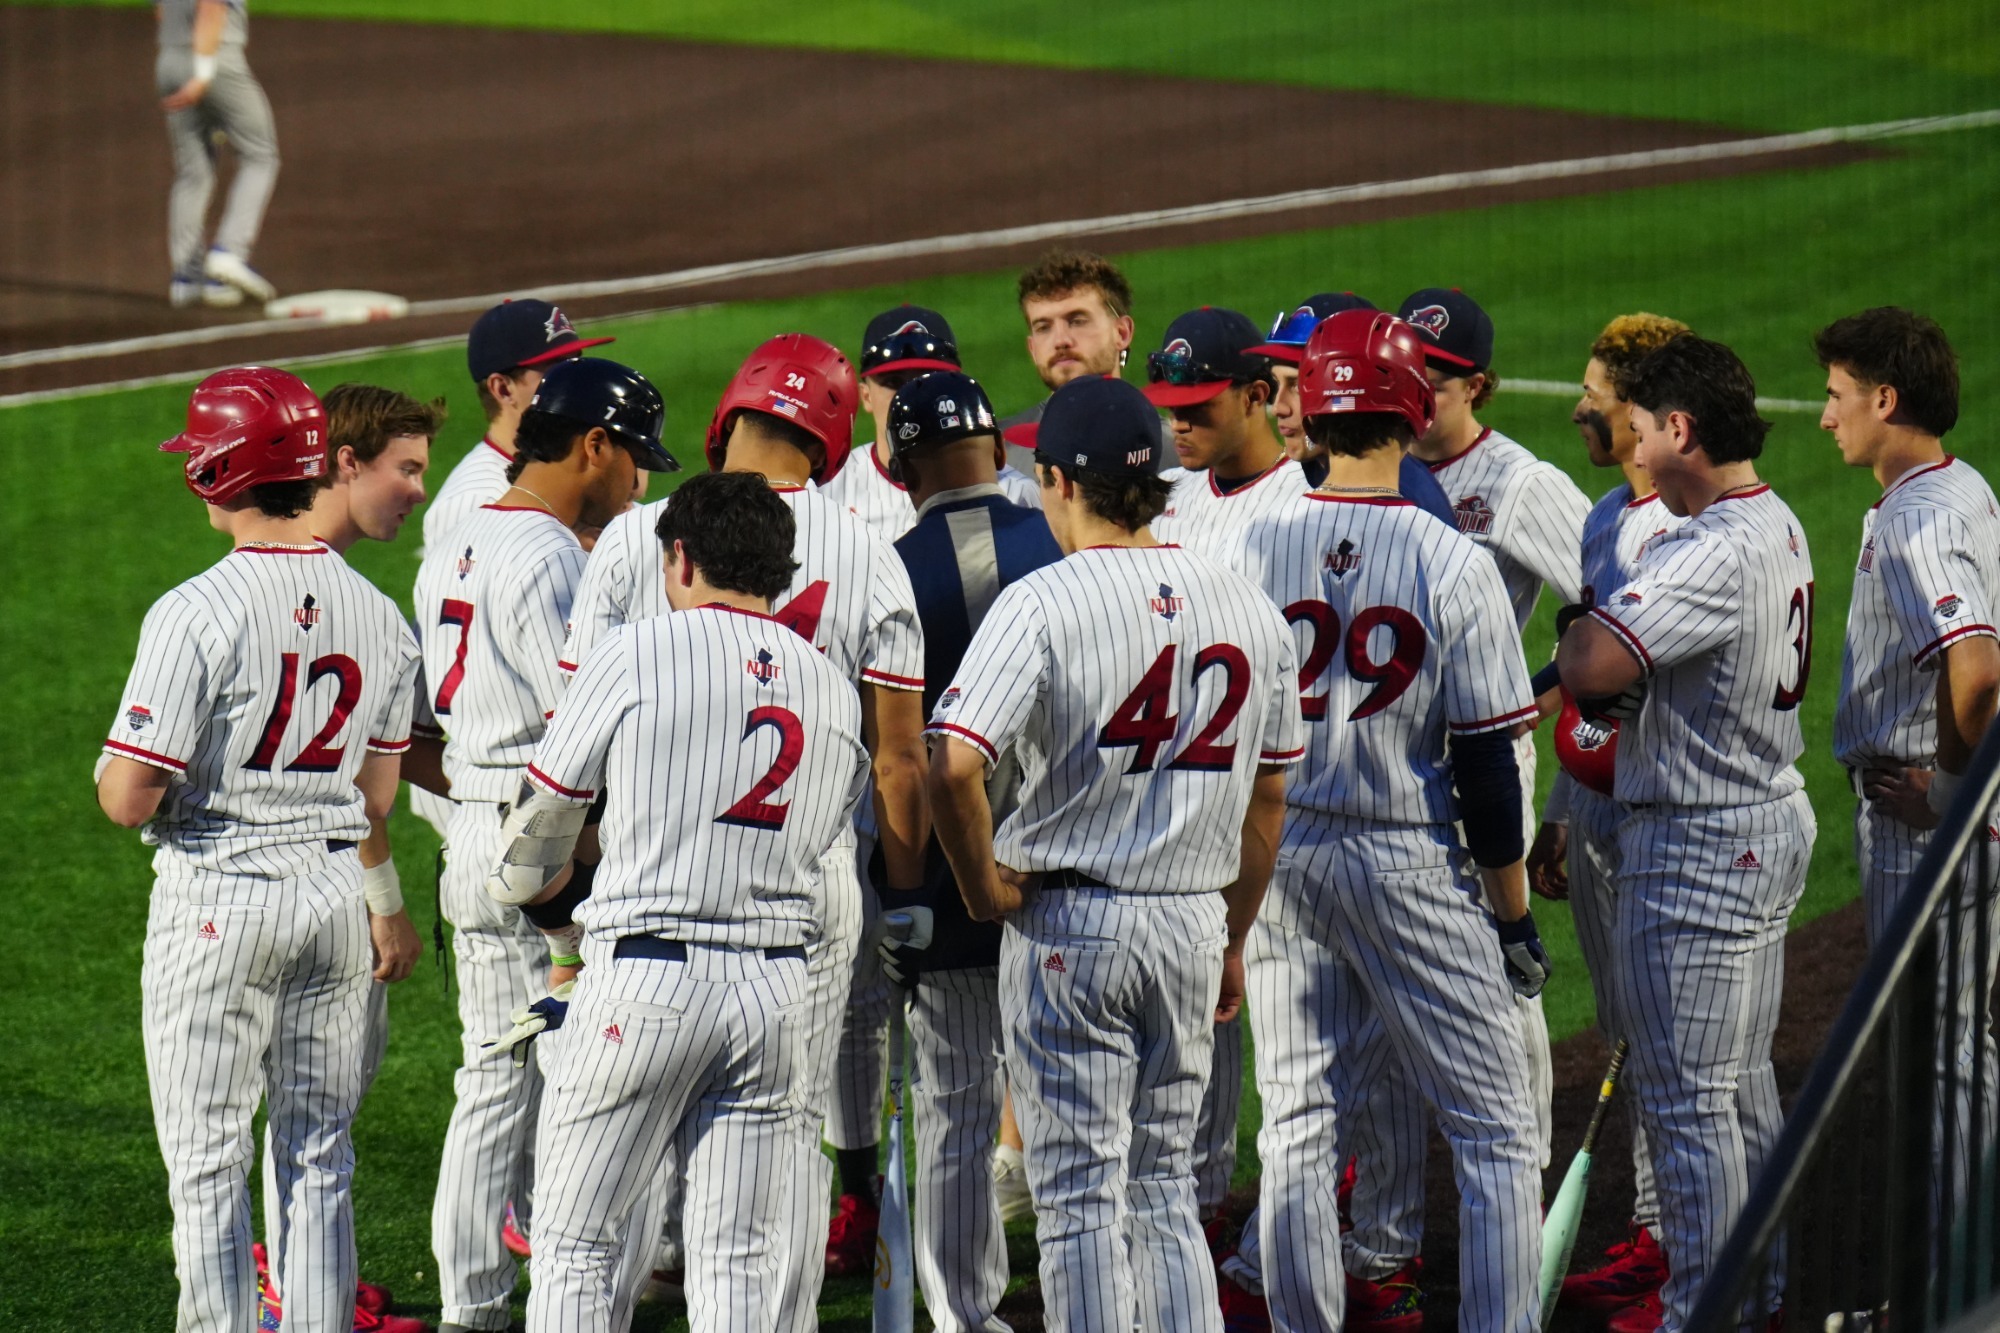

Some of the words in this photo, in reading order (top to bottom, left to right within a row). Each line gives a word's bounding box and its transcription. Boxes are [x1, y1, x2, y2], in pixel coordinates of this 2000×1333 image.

[785, 372, 806, 391] 24
[1334, 366, 1353, 381] 29
[604, 406, 616, 420] 7
[938, 399, 956, 414] 40
[306, 430, 319, 446] 12
[1127, 447, 1152, 467] NJIT
[1324, 552, 1362, 570] NJIT
[1150, 596, 1184, 614] NJIT
[294, 608, 321, 624] NJIT
[435, 598, 475, 715] 7
[1282, 599, 1426, 722] 29
[747, 659, 781, 680] NJIT
[240, 652, 363, 772] 12
[1097, 643, 1251, 775] 42
[713, 705, 804, 832] 2
